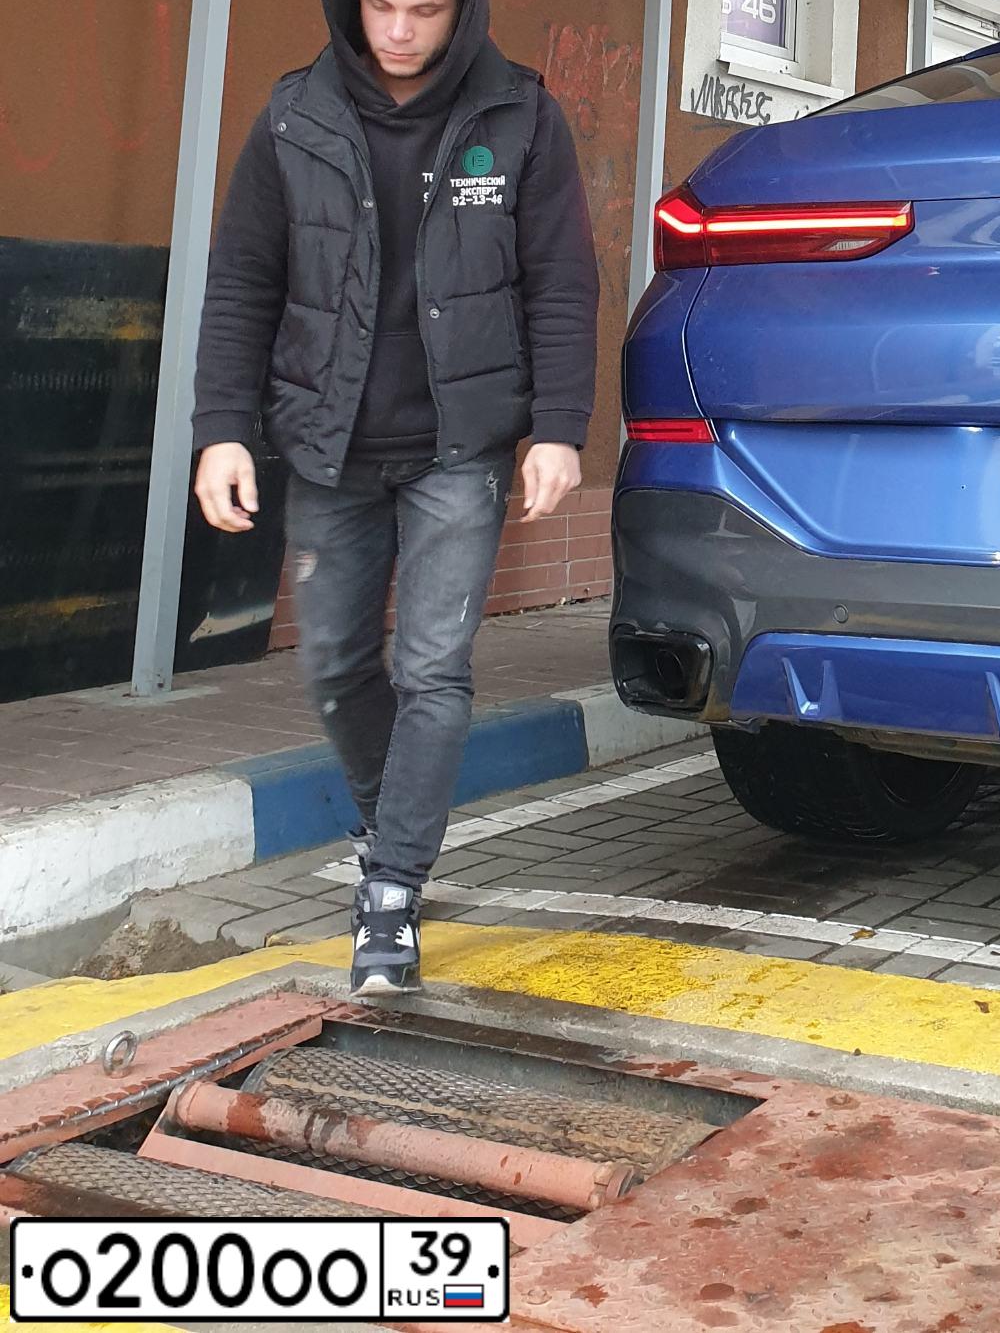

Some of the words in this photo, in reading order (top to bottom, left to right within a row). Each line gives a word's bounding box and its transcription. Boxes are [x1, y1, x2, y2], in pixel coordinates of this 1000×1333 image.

[449, 175, 506, 187] ТЕХНИЧЕСКИЙ
[460, 186, 498, 196] ЭКСПЕРТ
[452, 194, 503, 206] 92-13-46
